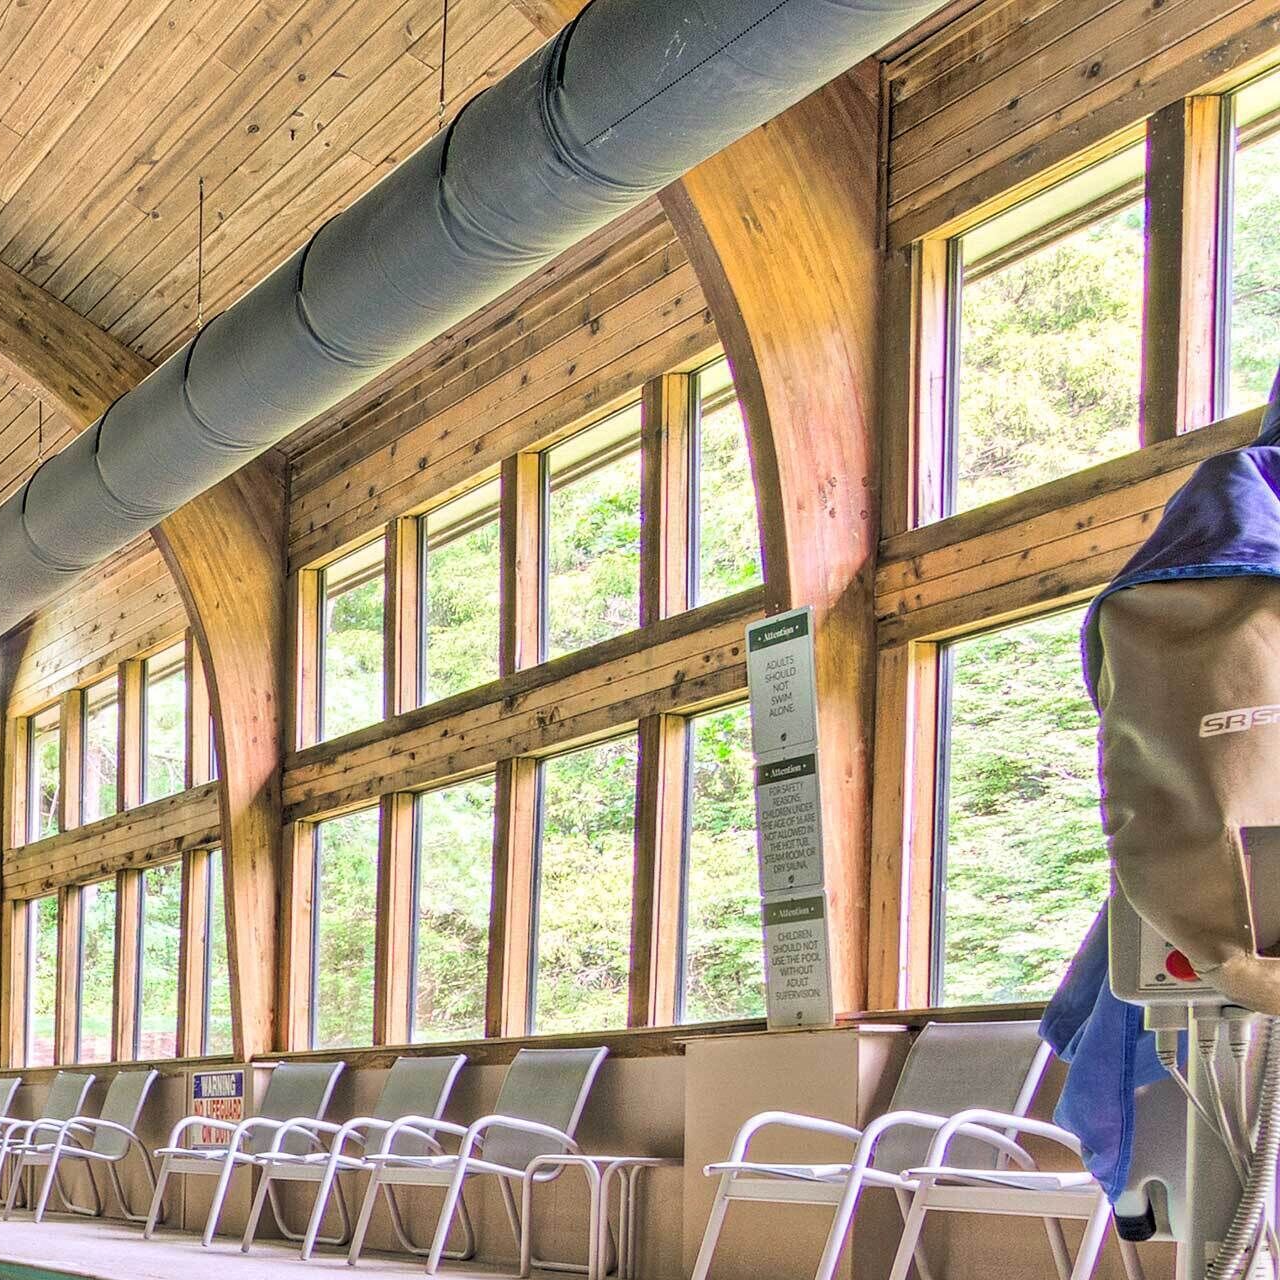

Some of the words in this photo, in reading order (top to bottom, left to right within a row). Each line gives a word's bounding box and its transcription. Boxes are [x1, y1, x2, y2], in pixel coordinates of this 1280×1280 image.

[763, 627, 794, 641] Attention
[766, 655, 794, 671] ADULTS
[765, 667, 796, 683] SHOULD
[773, 681, 789, 693] NOT
[771, 692, 792, 706] SWIM
[1204, 714, 1246, 733] SR
[771, 763, 801, 778] Attention
[780, 907, 809, 918] Attention
[778, 929, 813, 941] CHILDREN
[773, 942, 802, 954] SHOULD
[803, 940, 818, 952] NOT
[772, 955, 785, 966] USE
[786, 954, 799, 964] THE
[801, 952, 822, 963] POOL
[780, 965, 813, 976] WITHOUT
[786, 977, 808, 988] ADULT
[201, 1073, 235, 1097] WARNING
